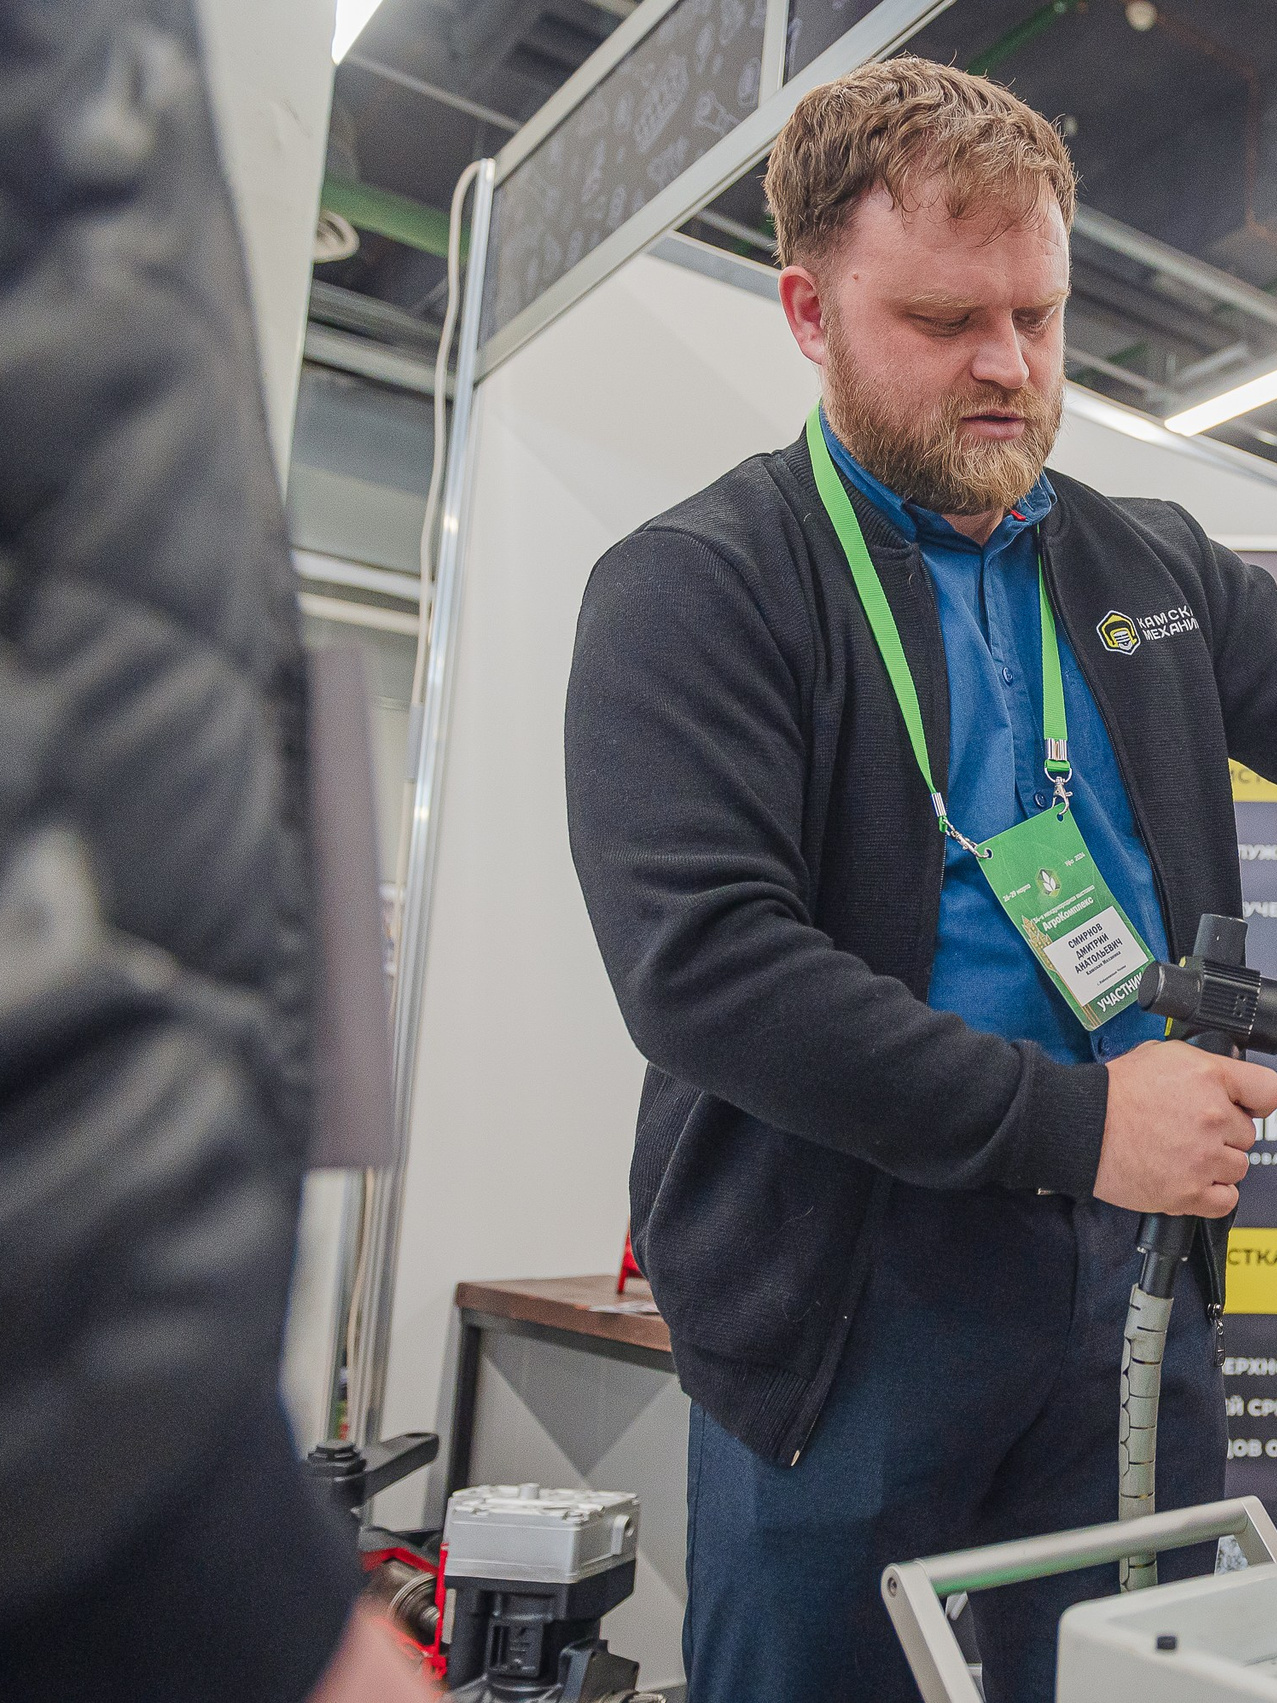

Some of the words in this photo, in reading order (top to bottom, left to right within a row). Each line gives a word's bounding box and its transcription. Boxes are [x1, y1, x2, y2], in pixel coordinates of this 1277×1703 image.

[1042, 896, 1094, 931] АгроКомплекс
[1068, 923, 1103, 949] СМИРНОВ
[1076, 932, 1109, 960] ДМИТРИЙ
[1074, 938, 1123, 974] АНАТОЛЬЕВИЧ
[1225, 1394, 1244, 1416] Й
